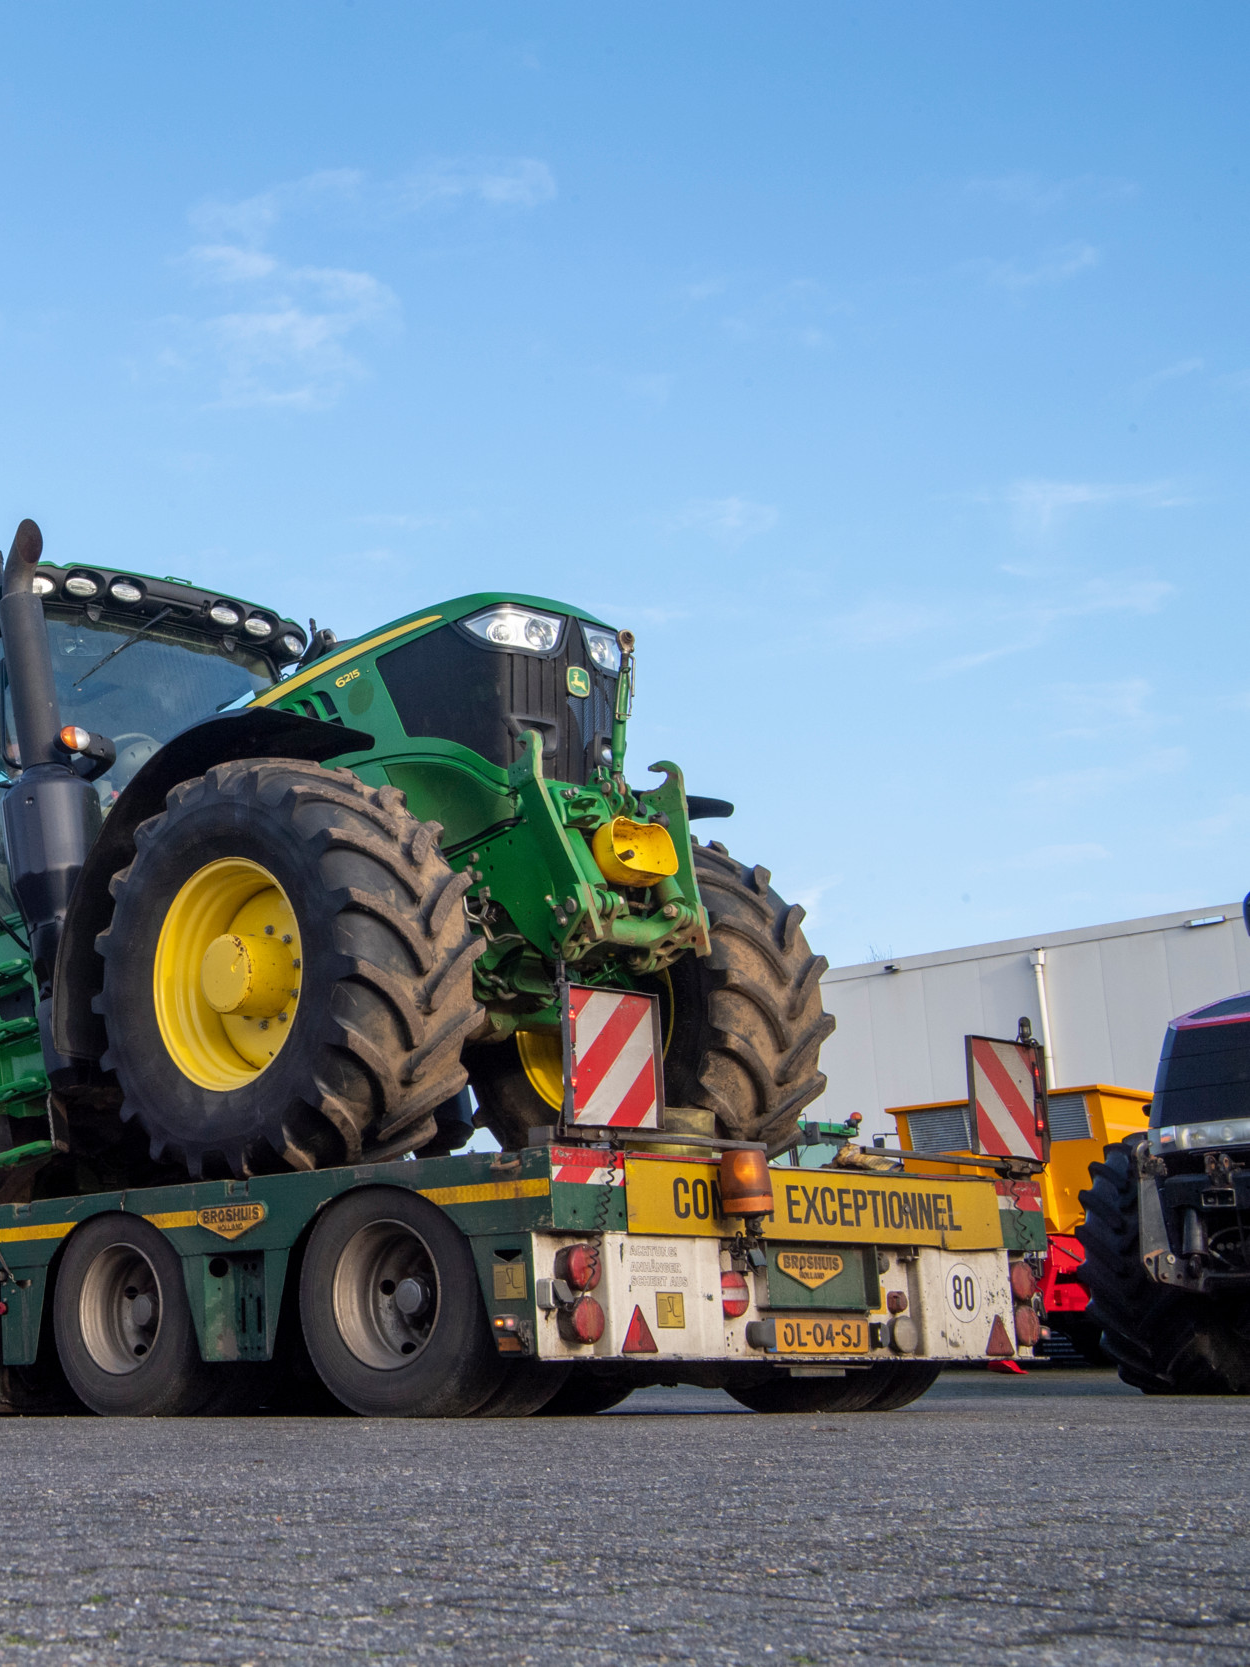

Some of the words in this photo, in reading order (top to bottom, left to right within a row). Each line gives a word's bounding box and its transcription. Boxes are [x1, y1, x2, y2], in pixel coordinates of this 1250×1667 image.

[335, 669, 360, 688] 6215
[203, 1207, 259, 1224] BROSHUIS
[785, 1184, 962, 1231] EXCEPTIONNEL
[782, 1255, 840, 1270] BROSHUIS
[631, 1275, 667, 1287] SCHERT
[670, 1276, 688, 1287] AUS
[799, 1271, 825, 1279] HOLLAND
[952, 1275, 974, 1311] 80
[783, 1323, 861, 1348] OL-04-SJ
